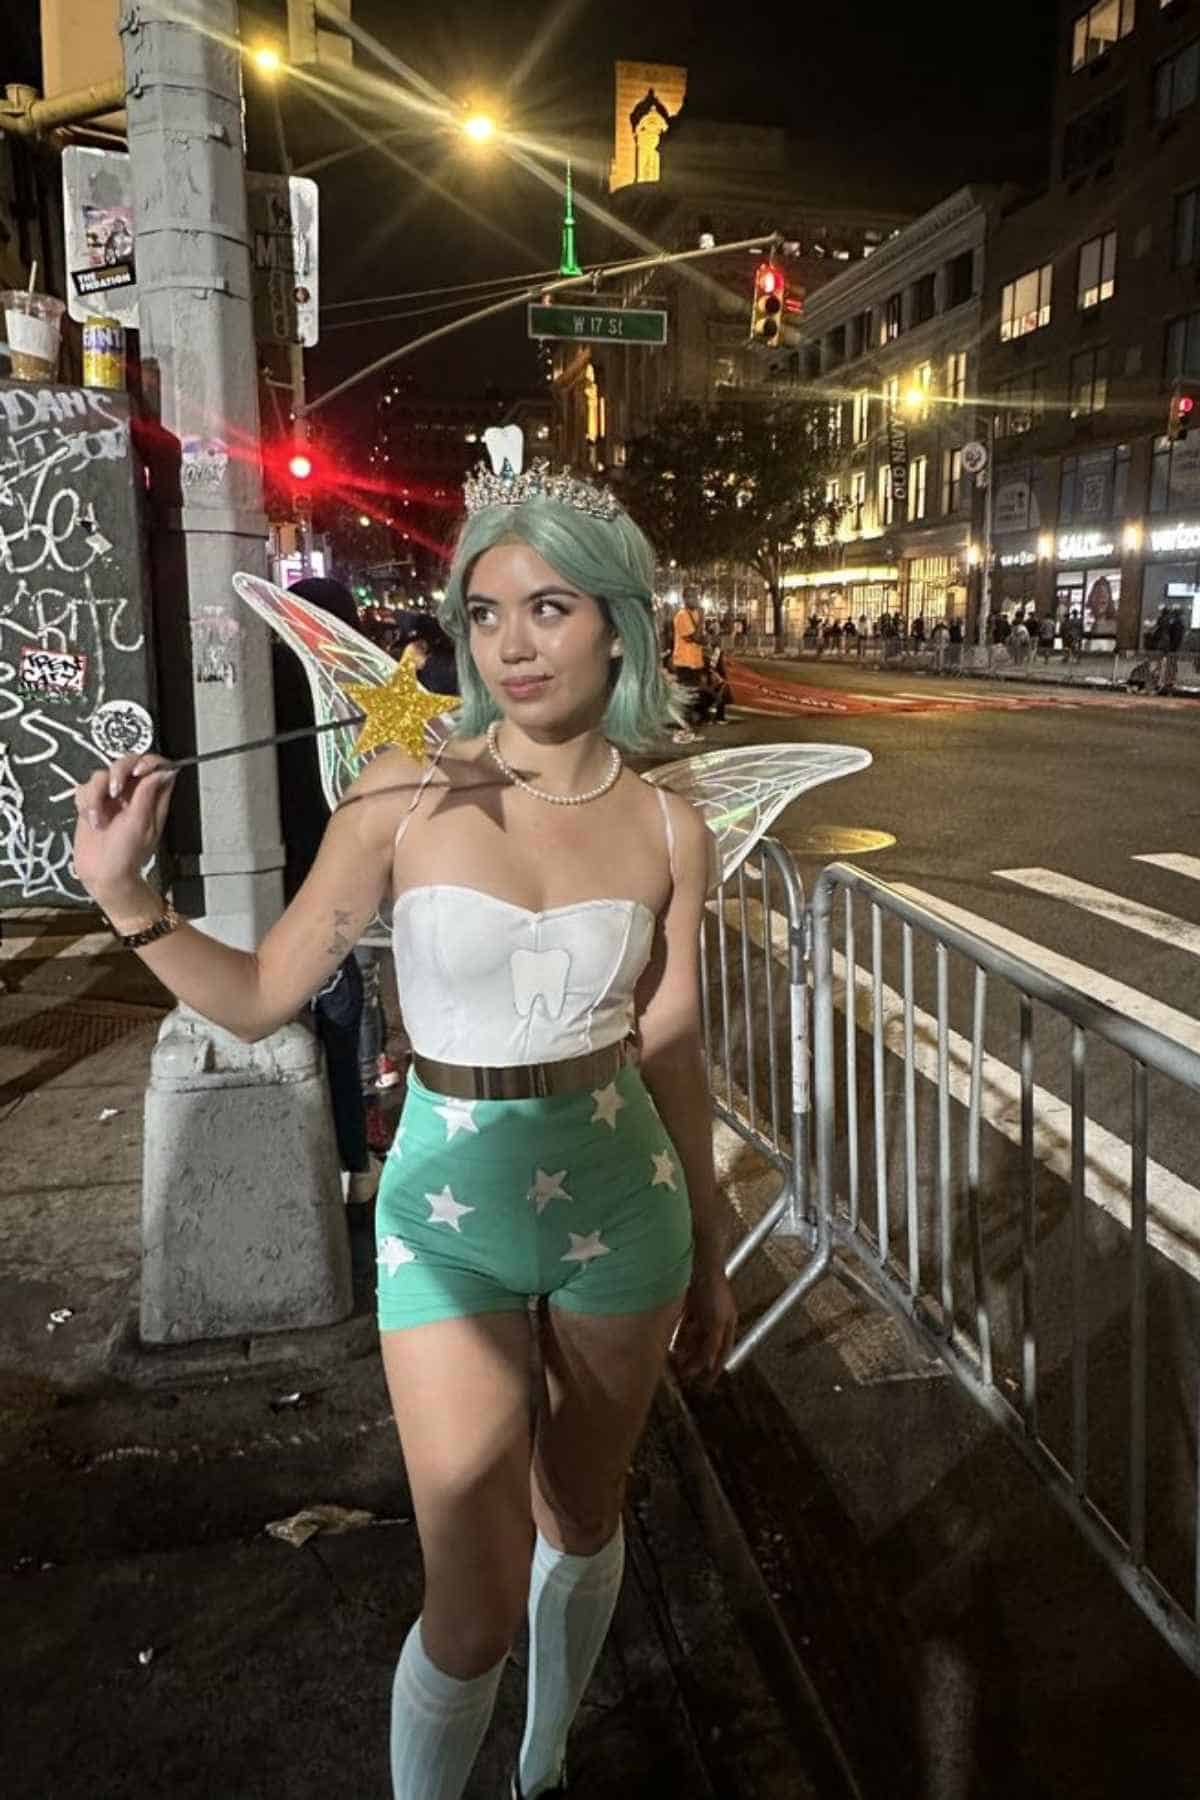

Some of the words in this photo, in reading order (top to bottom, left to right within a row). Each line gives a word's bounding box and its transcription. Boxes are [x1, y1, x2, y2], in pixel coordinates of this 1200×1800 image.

[573, 315, 585, 333] W
[591, 317, 603, 334] 17
[608, 317, 623, 335] St
[891, 466, 906, 499] OLD
